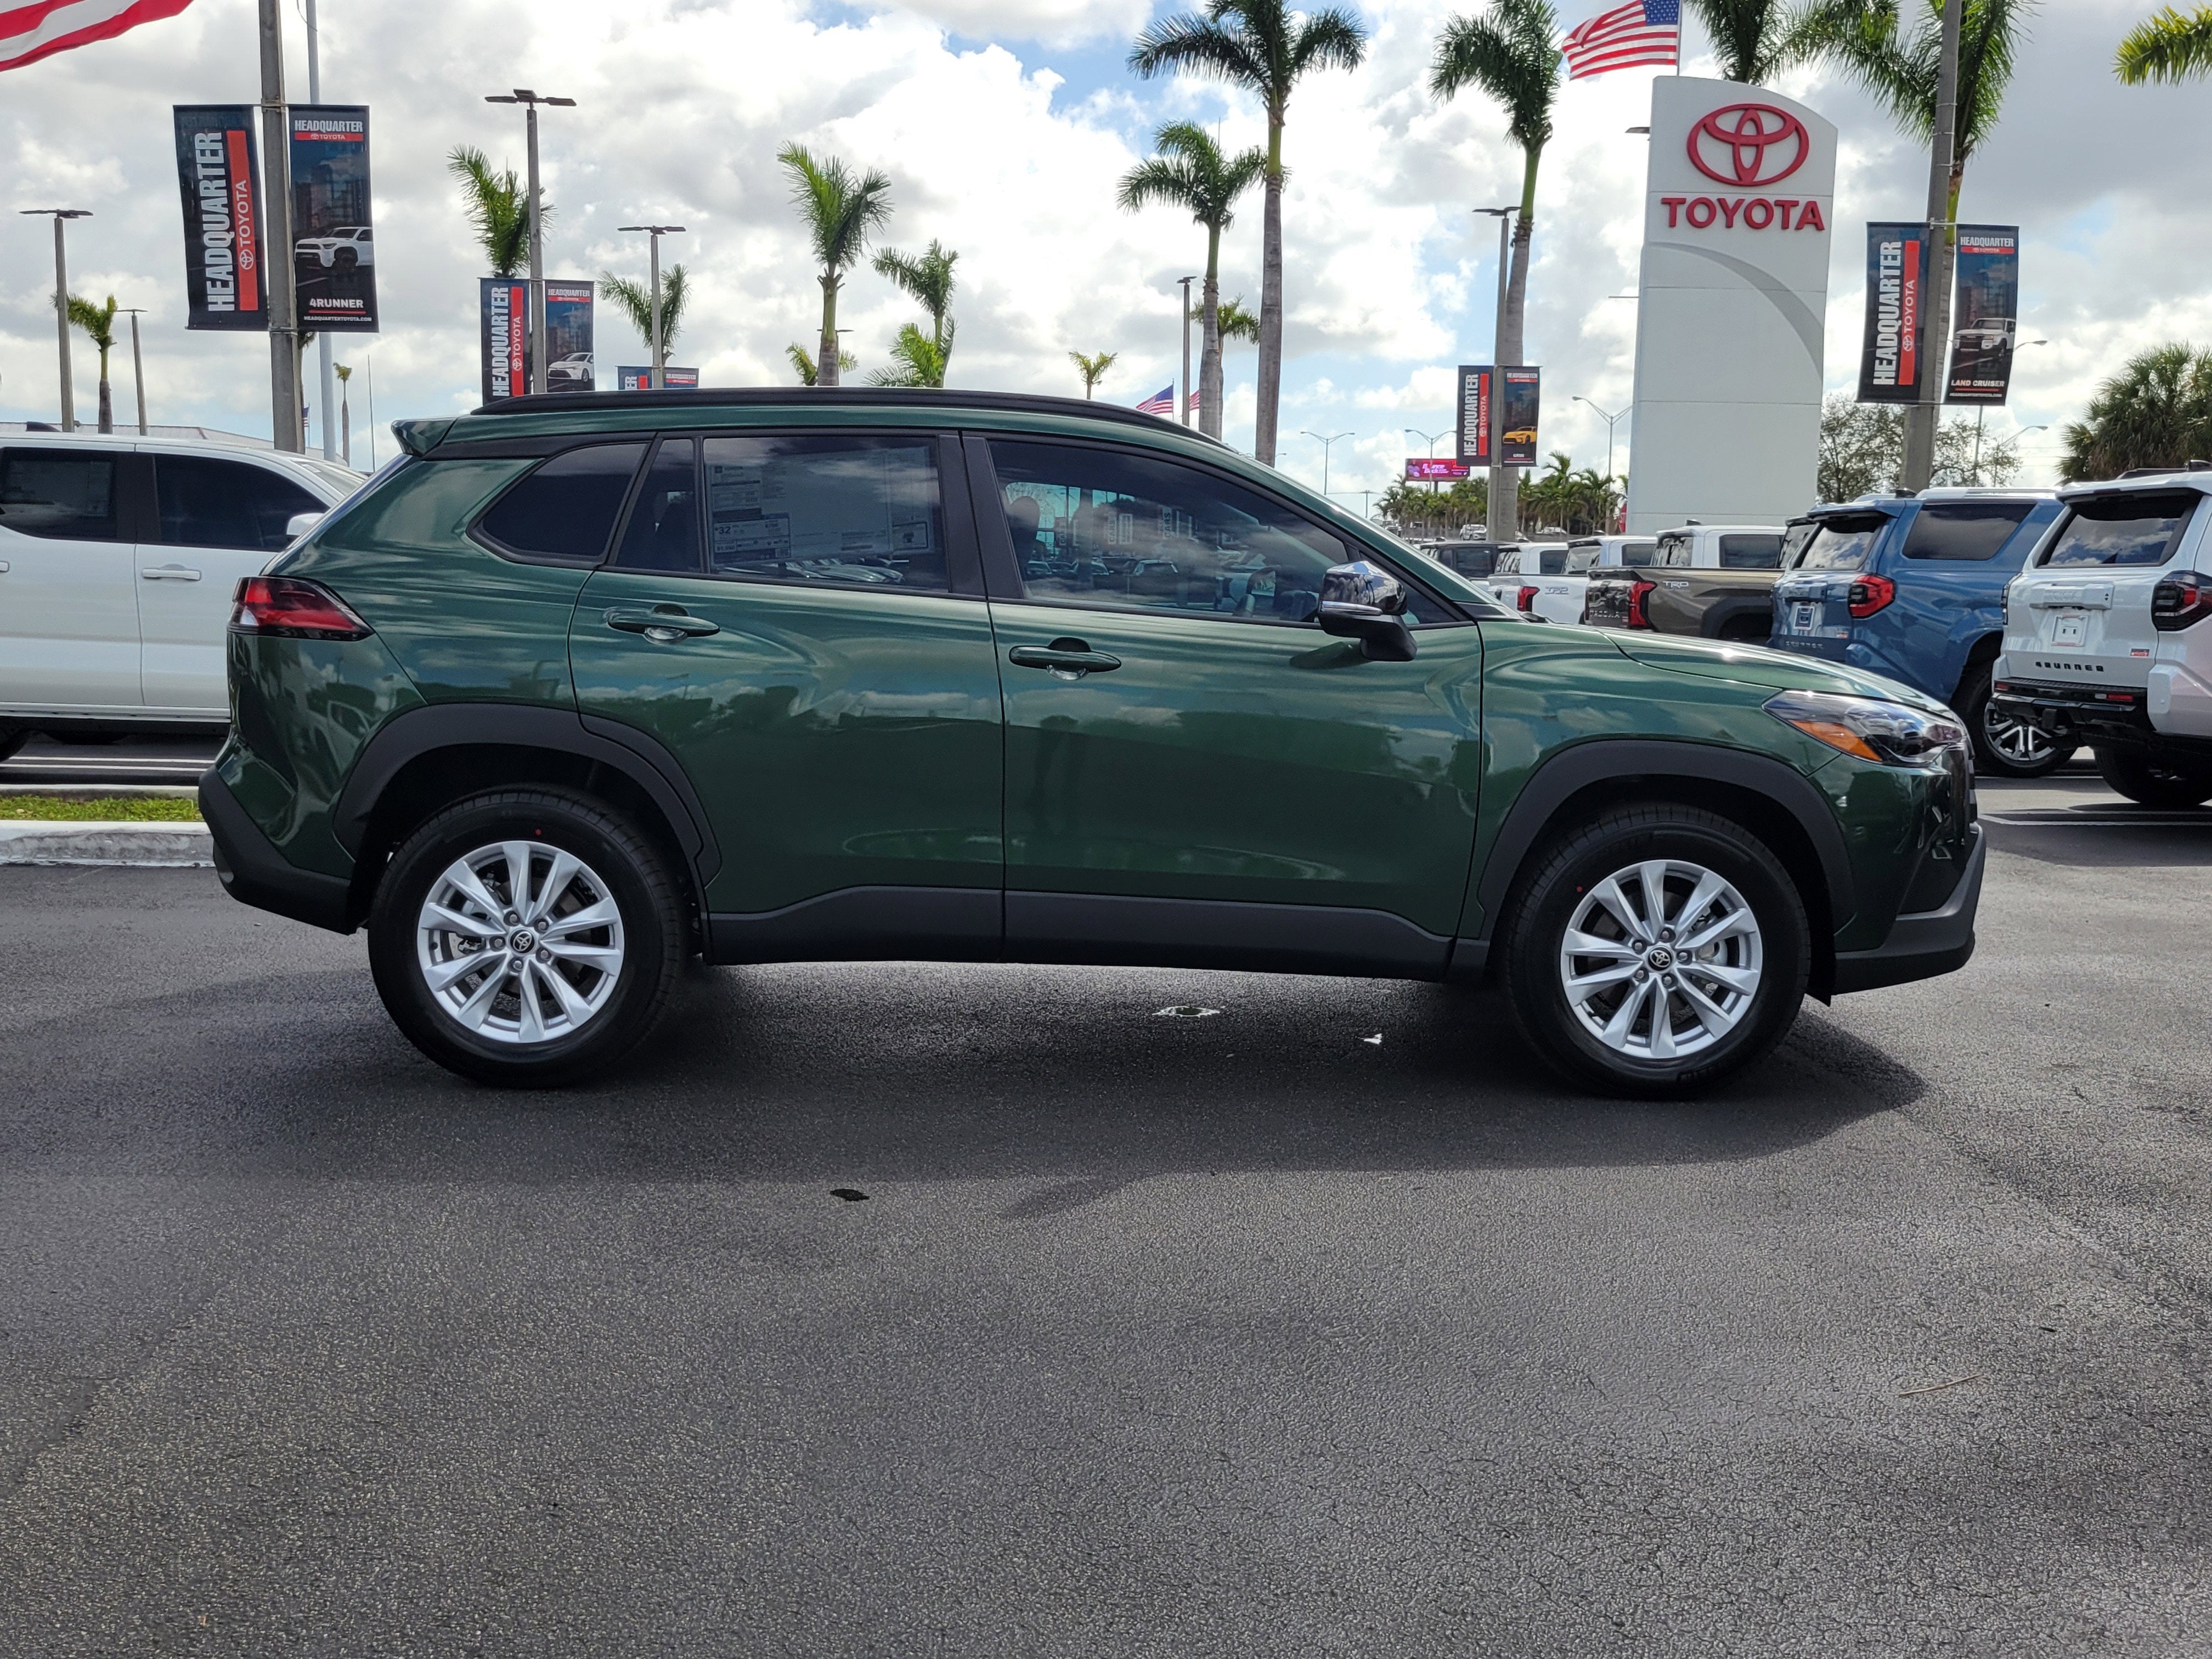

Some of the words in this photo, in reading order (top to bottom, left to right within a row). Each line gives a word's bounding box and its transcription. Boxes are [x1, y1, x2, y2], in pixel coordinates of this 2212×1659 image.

[295, 120, 363, 133] HEADQUARTER
[194, 132, 235, 312] HEADQUARTER
[235, 180, 252, 247] TOYOTA
[1661, 196, 1825, 232] TOYOTA
[1960, 236, 2014, 247] HEADQUARTER
[309, 298, 364, 308] 4RUNNER
[1873, 241, 1902, 385] HEADQUARTER
[1903, 280, 1915, 333] TOYOTA
[491, 287, 510, 397] HEADQUARTER
[513, 316, 521, 357] TOYOTA
[1463, 374, 1479, 456] HEADQUARTER
[2035, 661, 2104, 673] 4RUNNER
